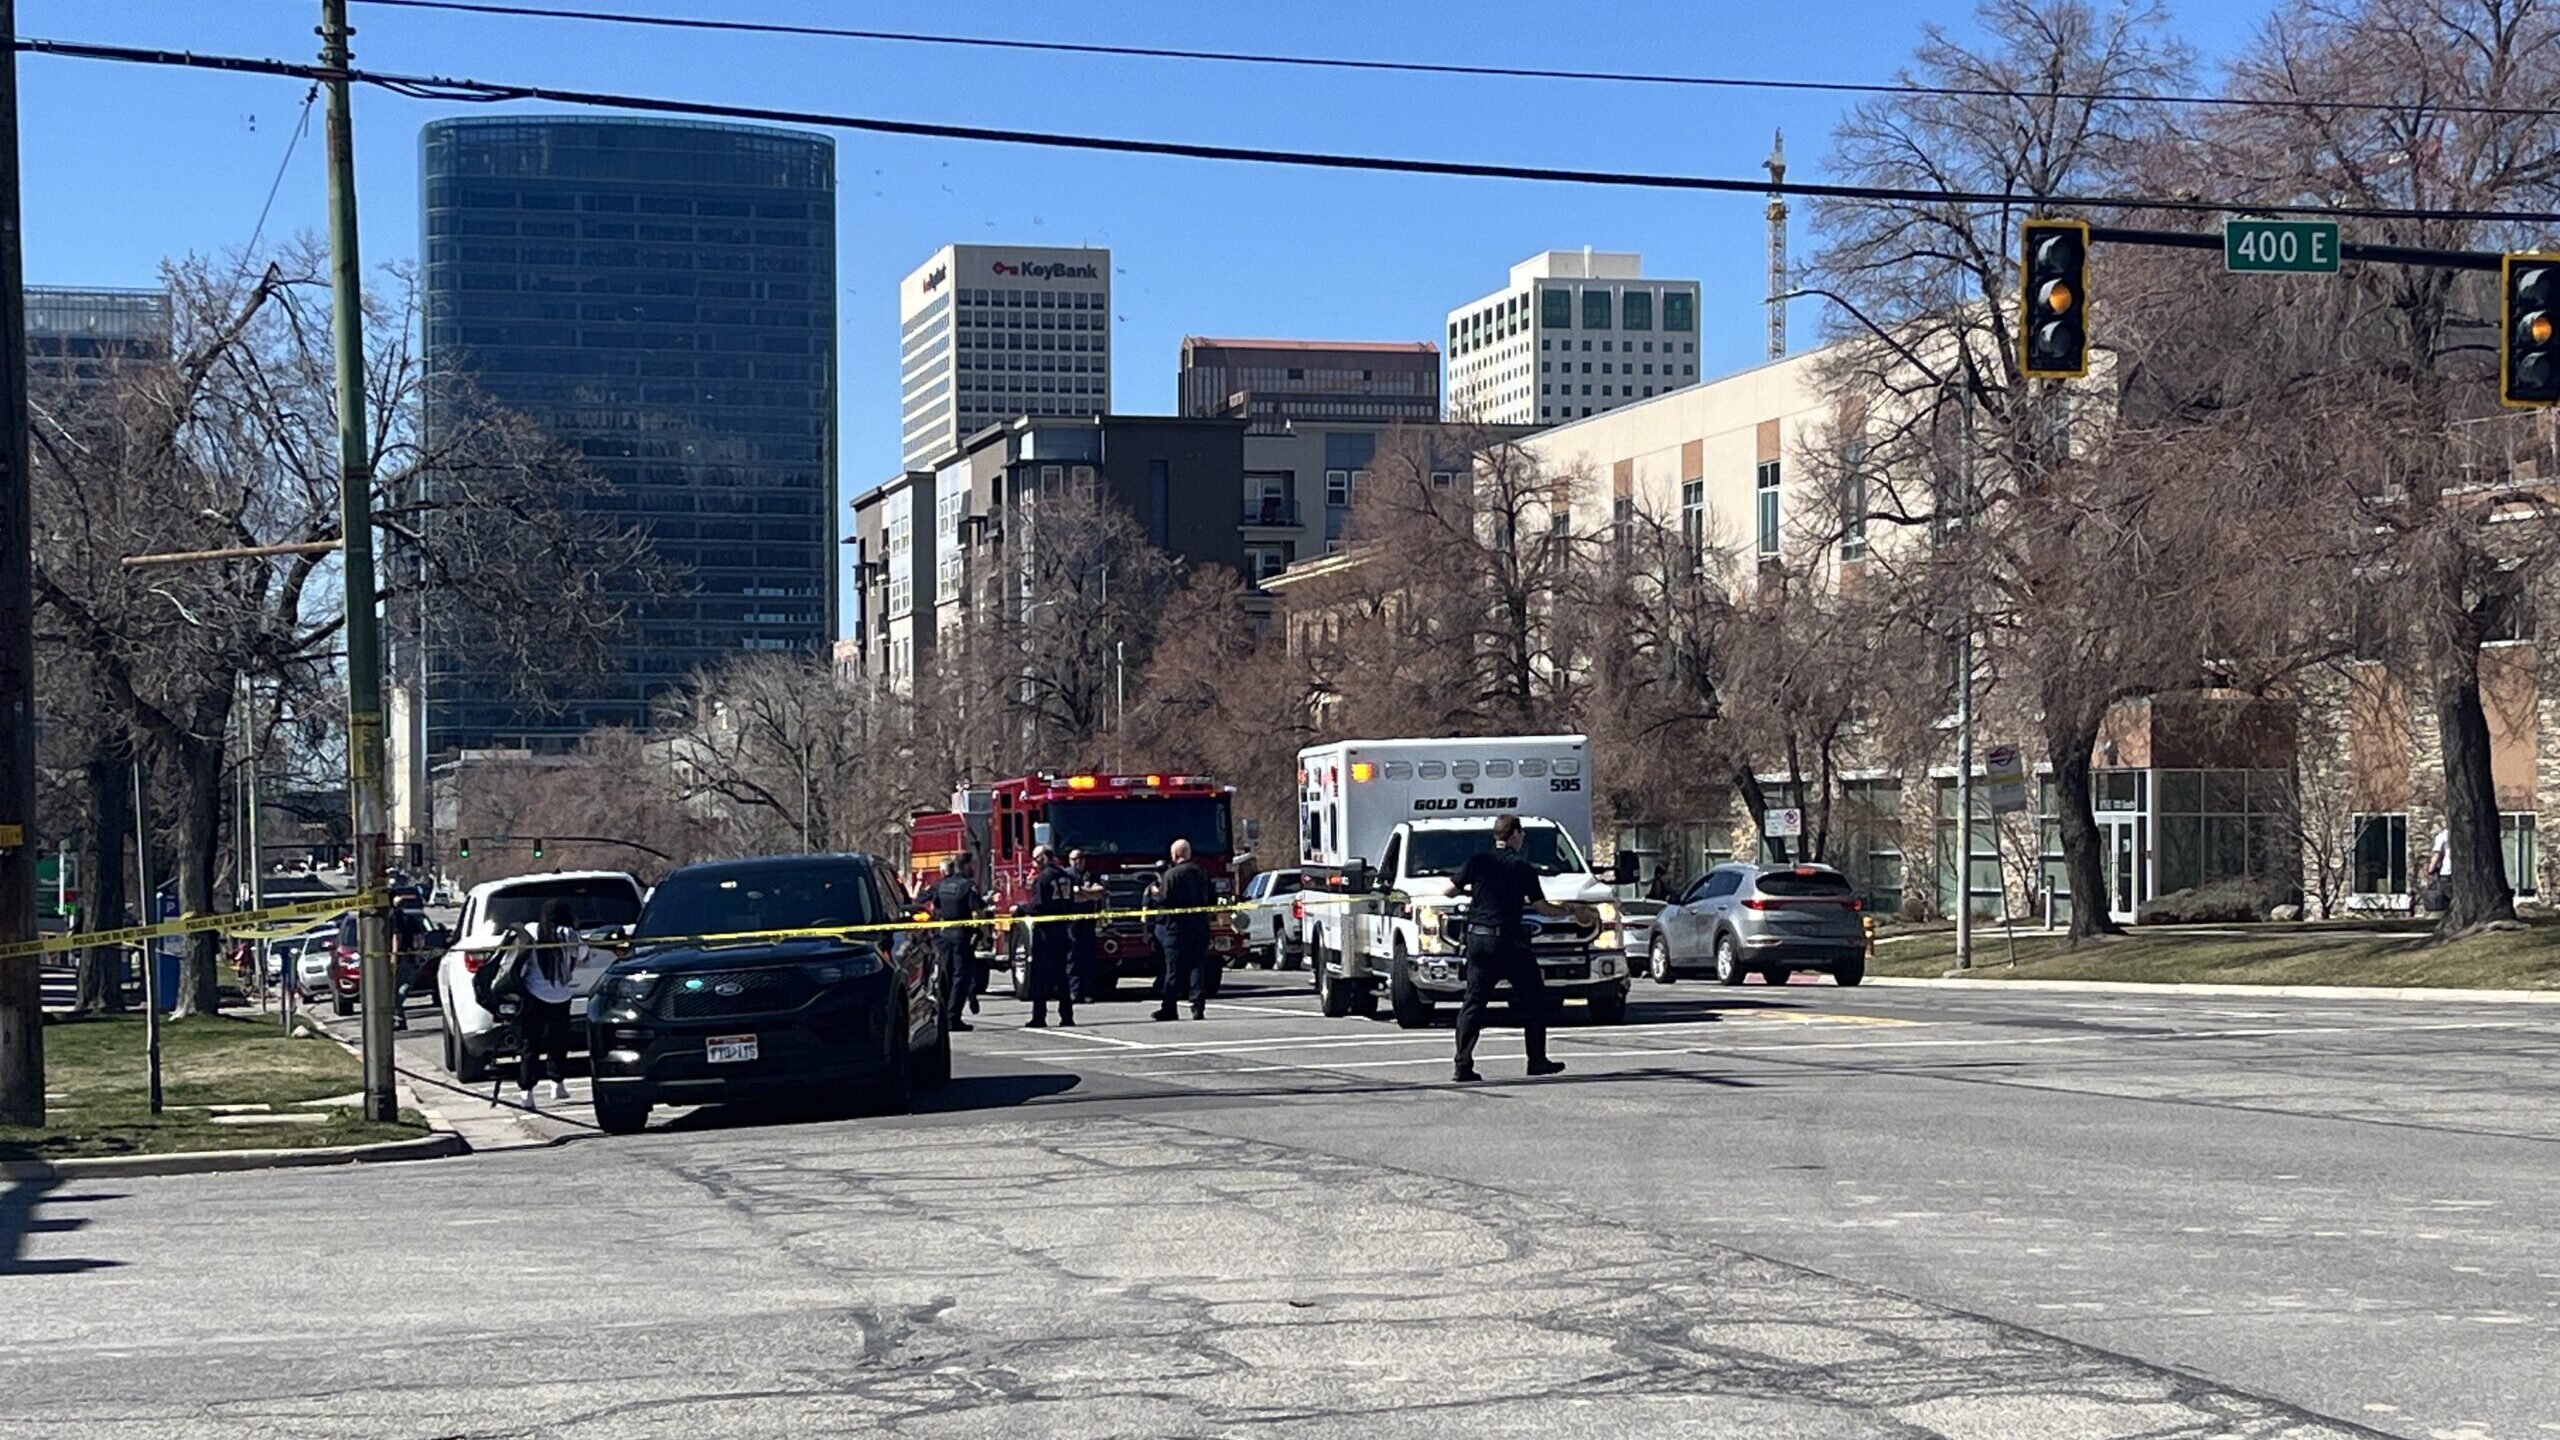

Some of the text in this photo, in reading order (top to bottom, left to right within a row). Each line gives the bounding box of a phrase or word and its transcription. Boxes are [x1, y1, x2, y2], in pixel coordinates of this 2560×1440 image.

[2238, 230, 2328, 263] 400 E
[1021, 261, 1098, 280] KeyBank
[1550, 778, 1581, 792] 595
[1414, 797, 1518, 810] GOLD CROSS
